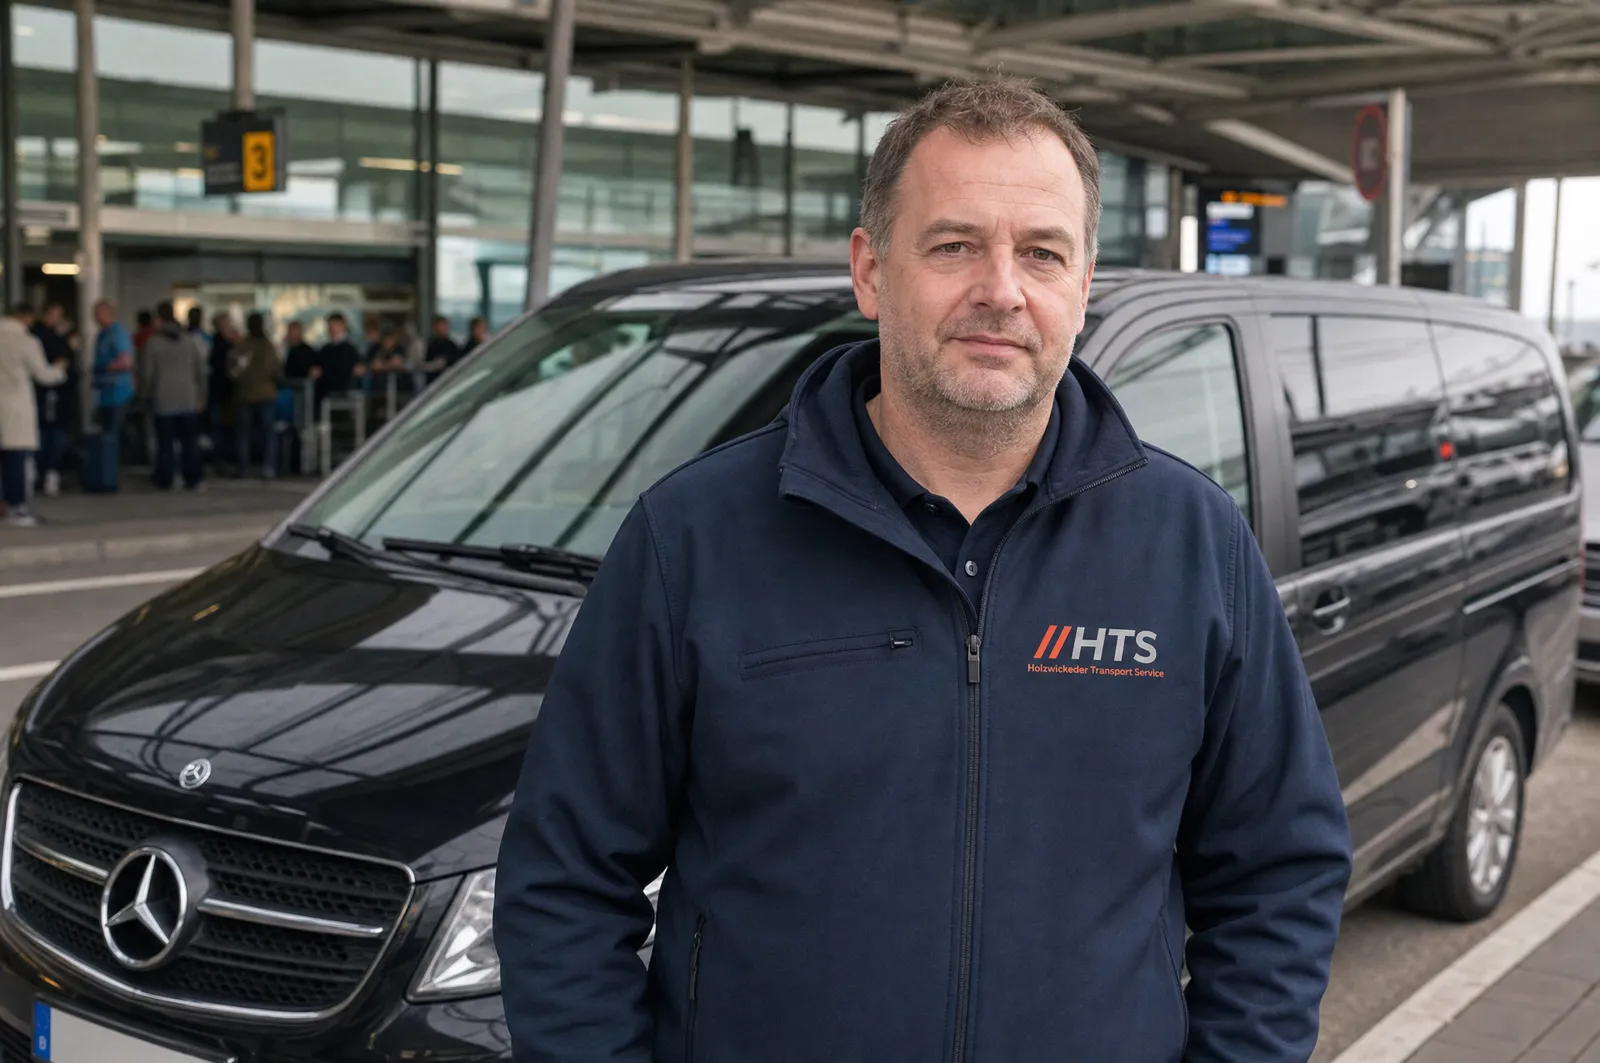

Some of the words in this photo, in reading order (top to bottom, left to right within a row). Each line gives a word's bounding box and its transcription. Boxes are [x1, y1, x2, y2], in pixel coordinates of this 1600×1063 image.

[250, 143, 268, 182] 3
[1027, 663, 1088, 675] Holzwickeder
[1090, 665, 1133, 677] Transport
[1134, 667, 1165, 678] Service
